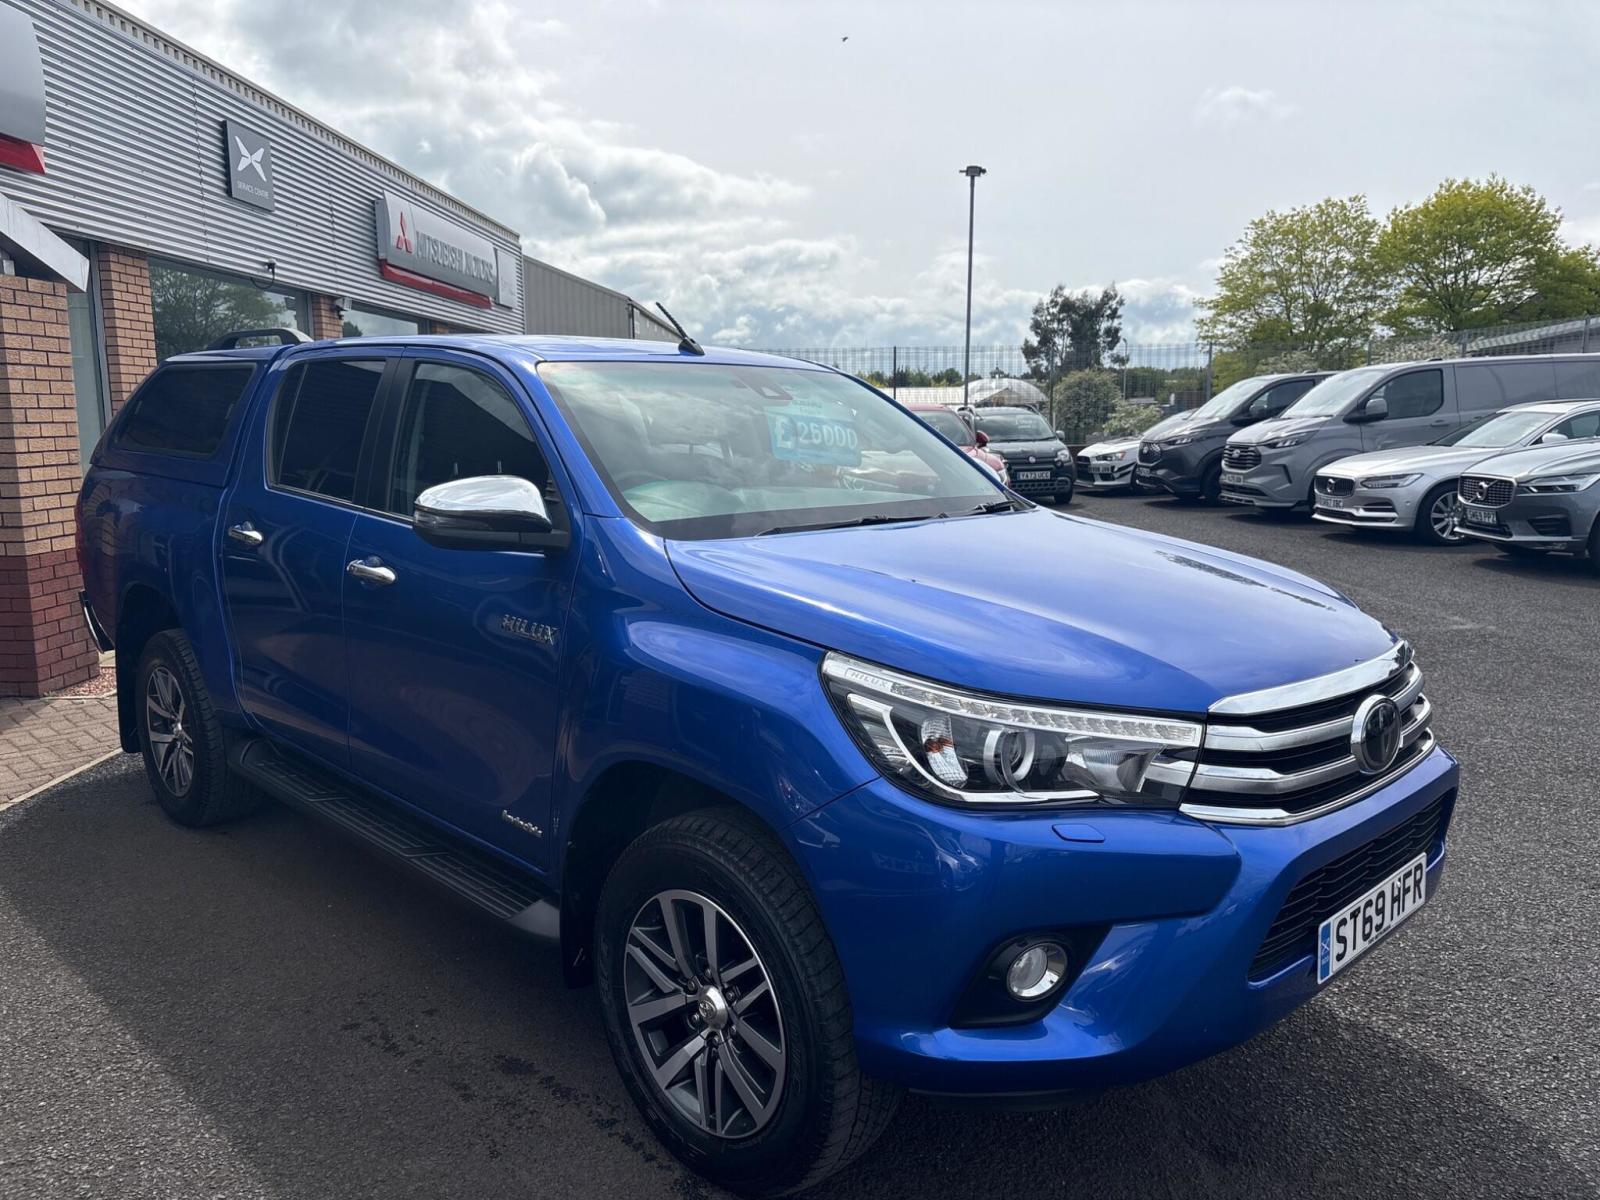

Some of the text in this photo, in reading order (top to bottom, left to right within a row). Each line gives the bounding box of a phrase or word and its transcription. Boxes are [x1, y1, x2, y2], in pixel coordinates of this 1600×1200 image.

[416, 231, 463, 272] MITSUBISHI
[502, 614, 558, 646] HILUX
[850, 671, 889, 688] HILUX
[1335, 862, 1424, 962] ST69 HFR
